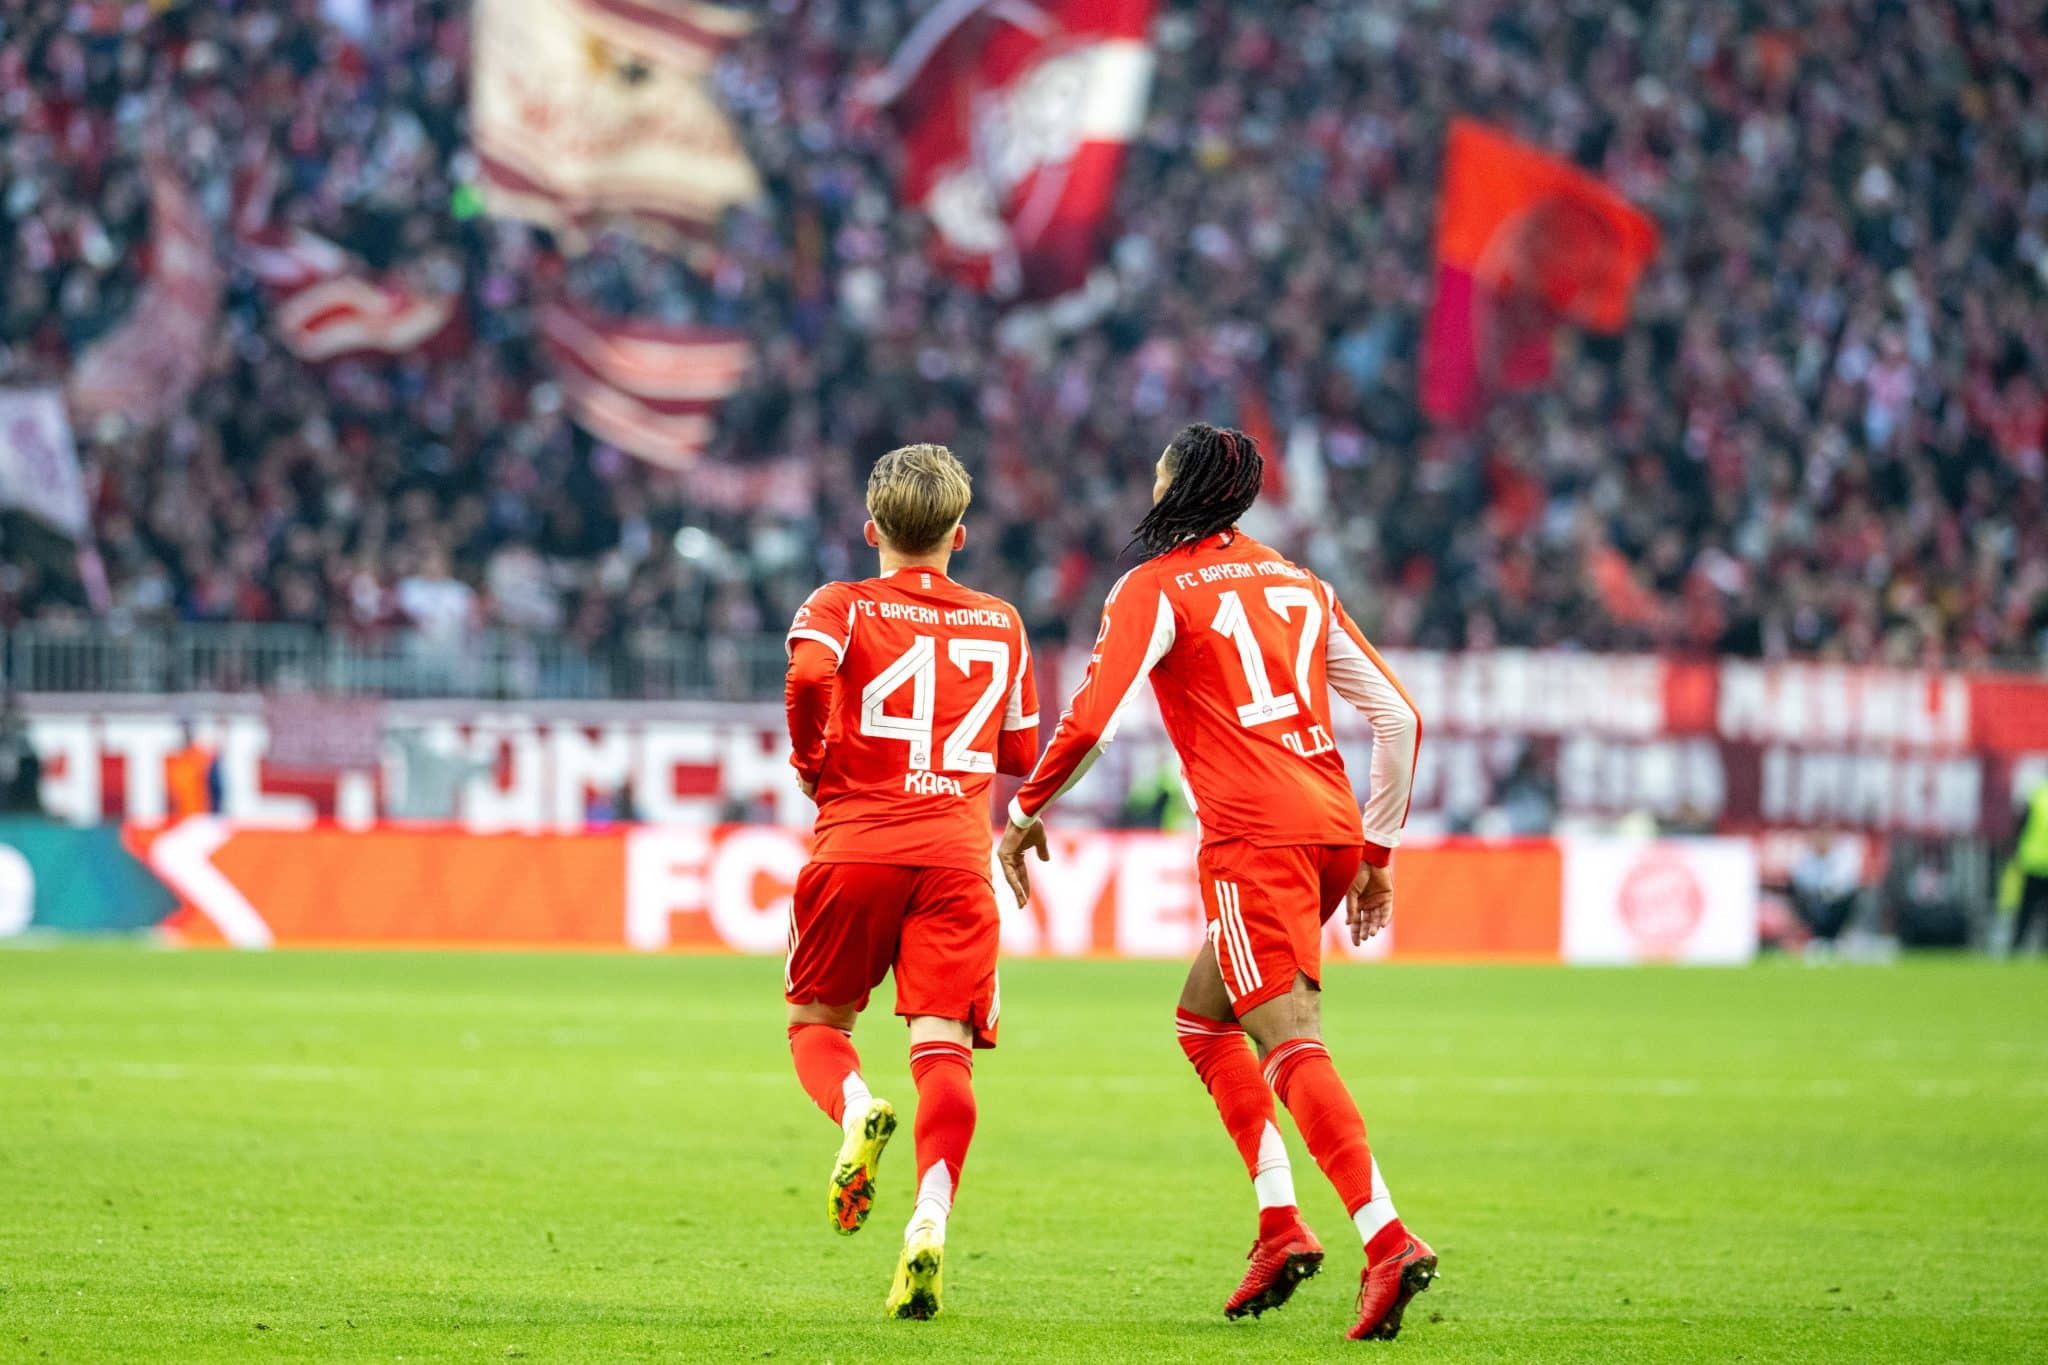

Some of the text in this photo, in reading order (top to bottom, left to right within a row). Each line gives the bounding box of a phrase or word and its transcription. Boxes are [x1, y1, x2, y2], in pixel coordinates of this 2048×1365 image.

[857, 599, 877, 617] FC
[880, 602, 939, 625] BAYERN
[1175, 572, 1199, 590] FC
[1198, 562, 1255, 583] BAYERN
[1210, 586, 1323, 728] 17
[860, 635, 1010, 773] 42
[904, 770, 966, 797] KARL
[626, 829, 808, 953] FC
